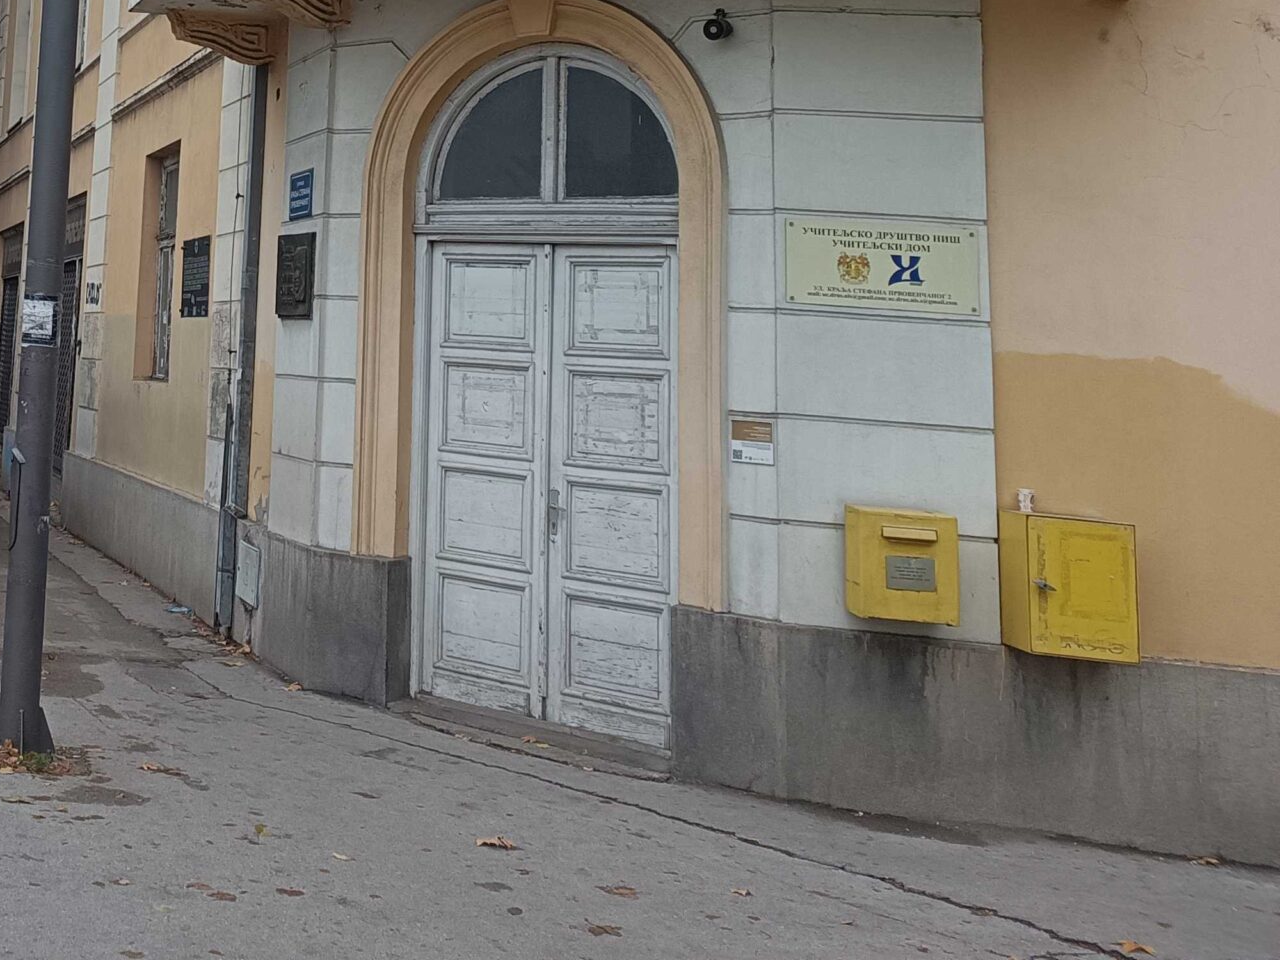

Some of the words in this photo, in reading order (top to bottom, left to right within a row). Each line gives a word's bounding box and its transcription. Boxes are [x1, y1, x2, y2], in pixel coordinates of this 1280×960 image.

[802, 226, 873, 239] УЧИТЕЉСКО
[874, 231, 931, 243] ДРУШТВО
[933, 234, 961, 244] НИШ
[832, 239, 903, 252] УЧИТЕЉСКИ
[904, 243, 931, 253] ДОМ
